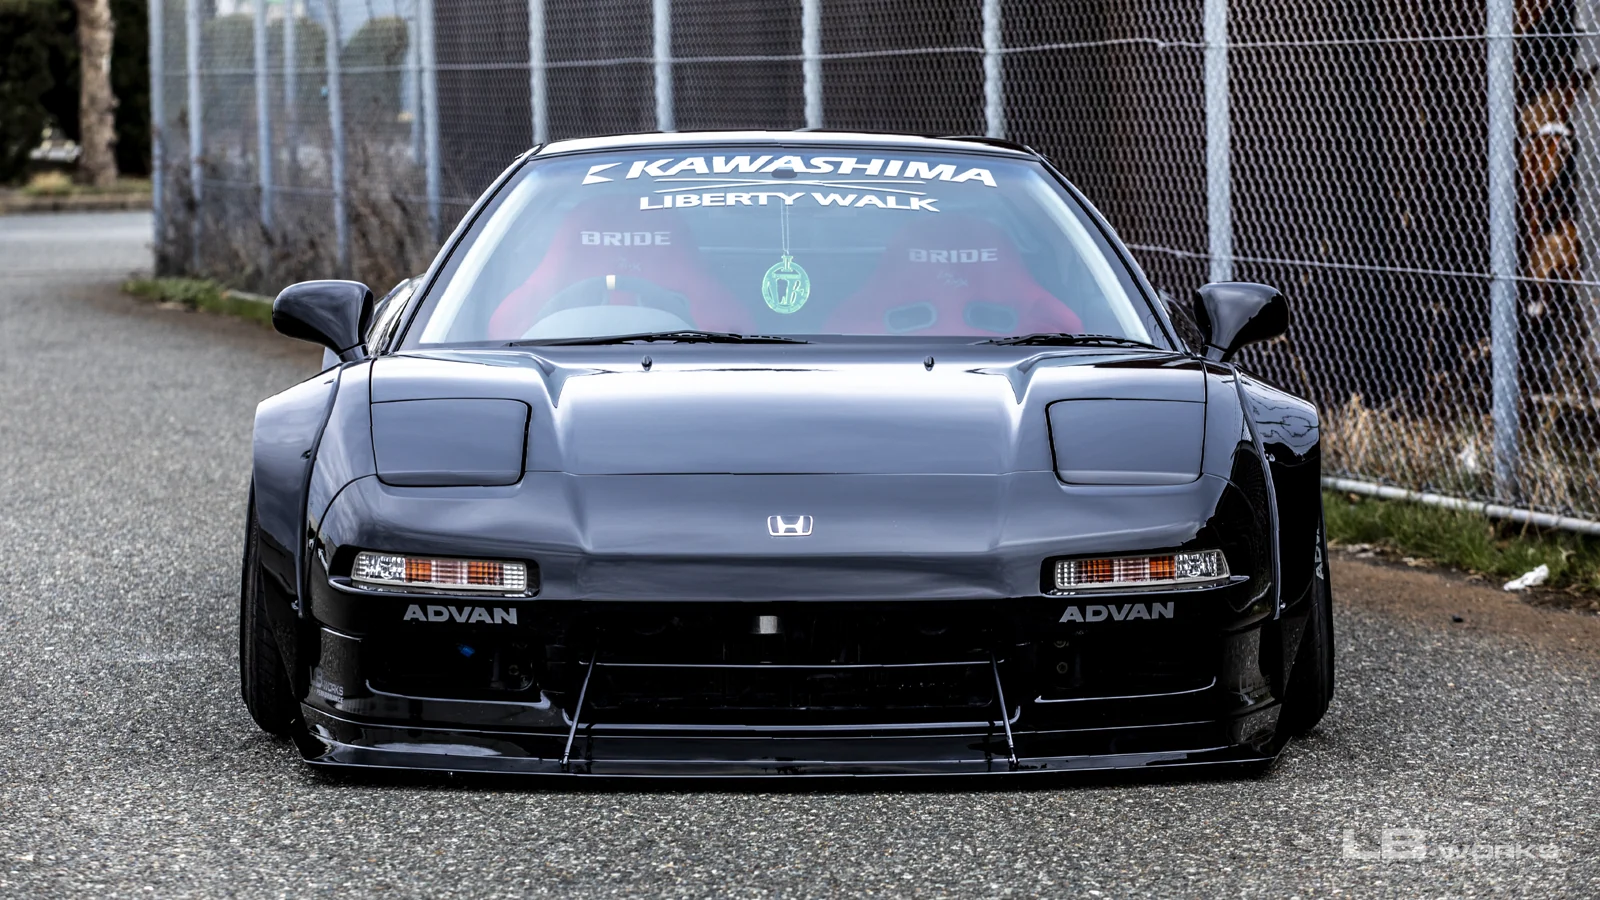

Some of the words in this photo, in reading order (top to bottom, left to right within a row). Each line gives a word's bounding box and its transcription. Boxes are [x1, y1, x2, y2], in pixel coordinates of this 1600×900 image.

[625, 155, 998, 188] KAWASHIMA
[639, 191, 806, 211] LIBERTY
[810, 192, 941, 212] WALK
[580, 231, 671, 246] BRIDE
[907, 248, 998, 263] BRIDE
[403, 604, 518, 625] ADVAN
[1058, 601, 1175, 623] ADVAN
